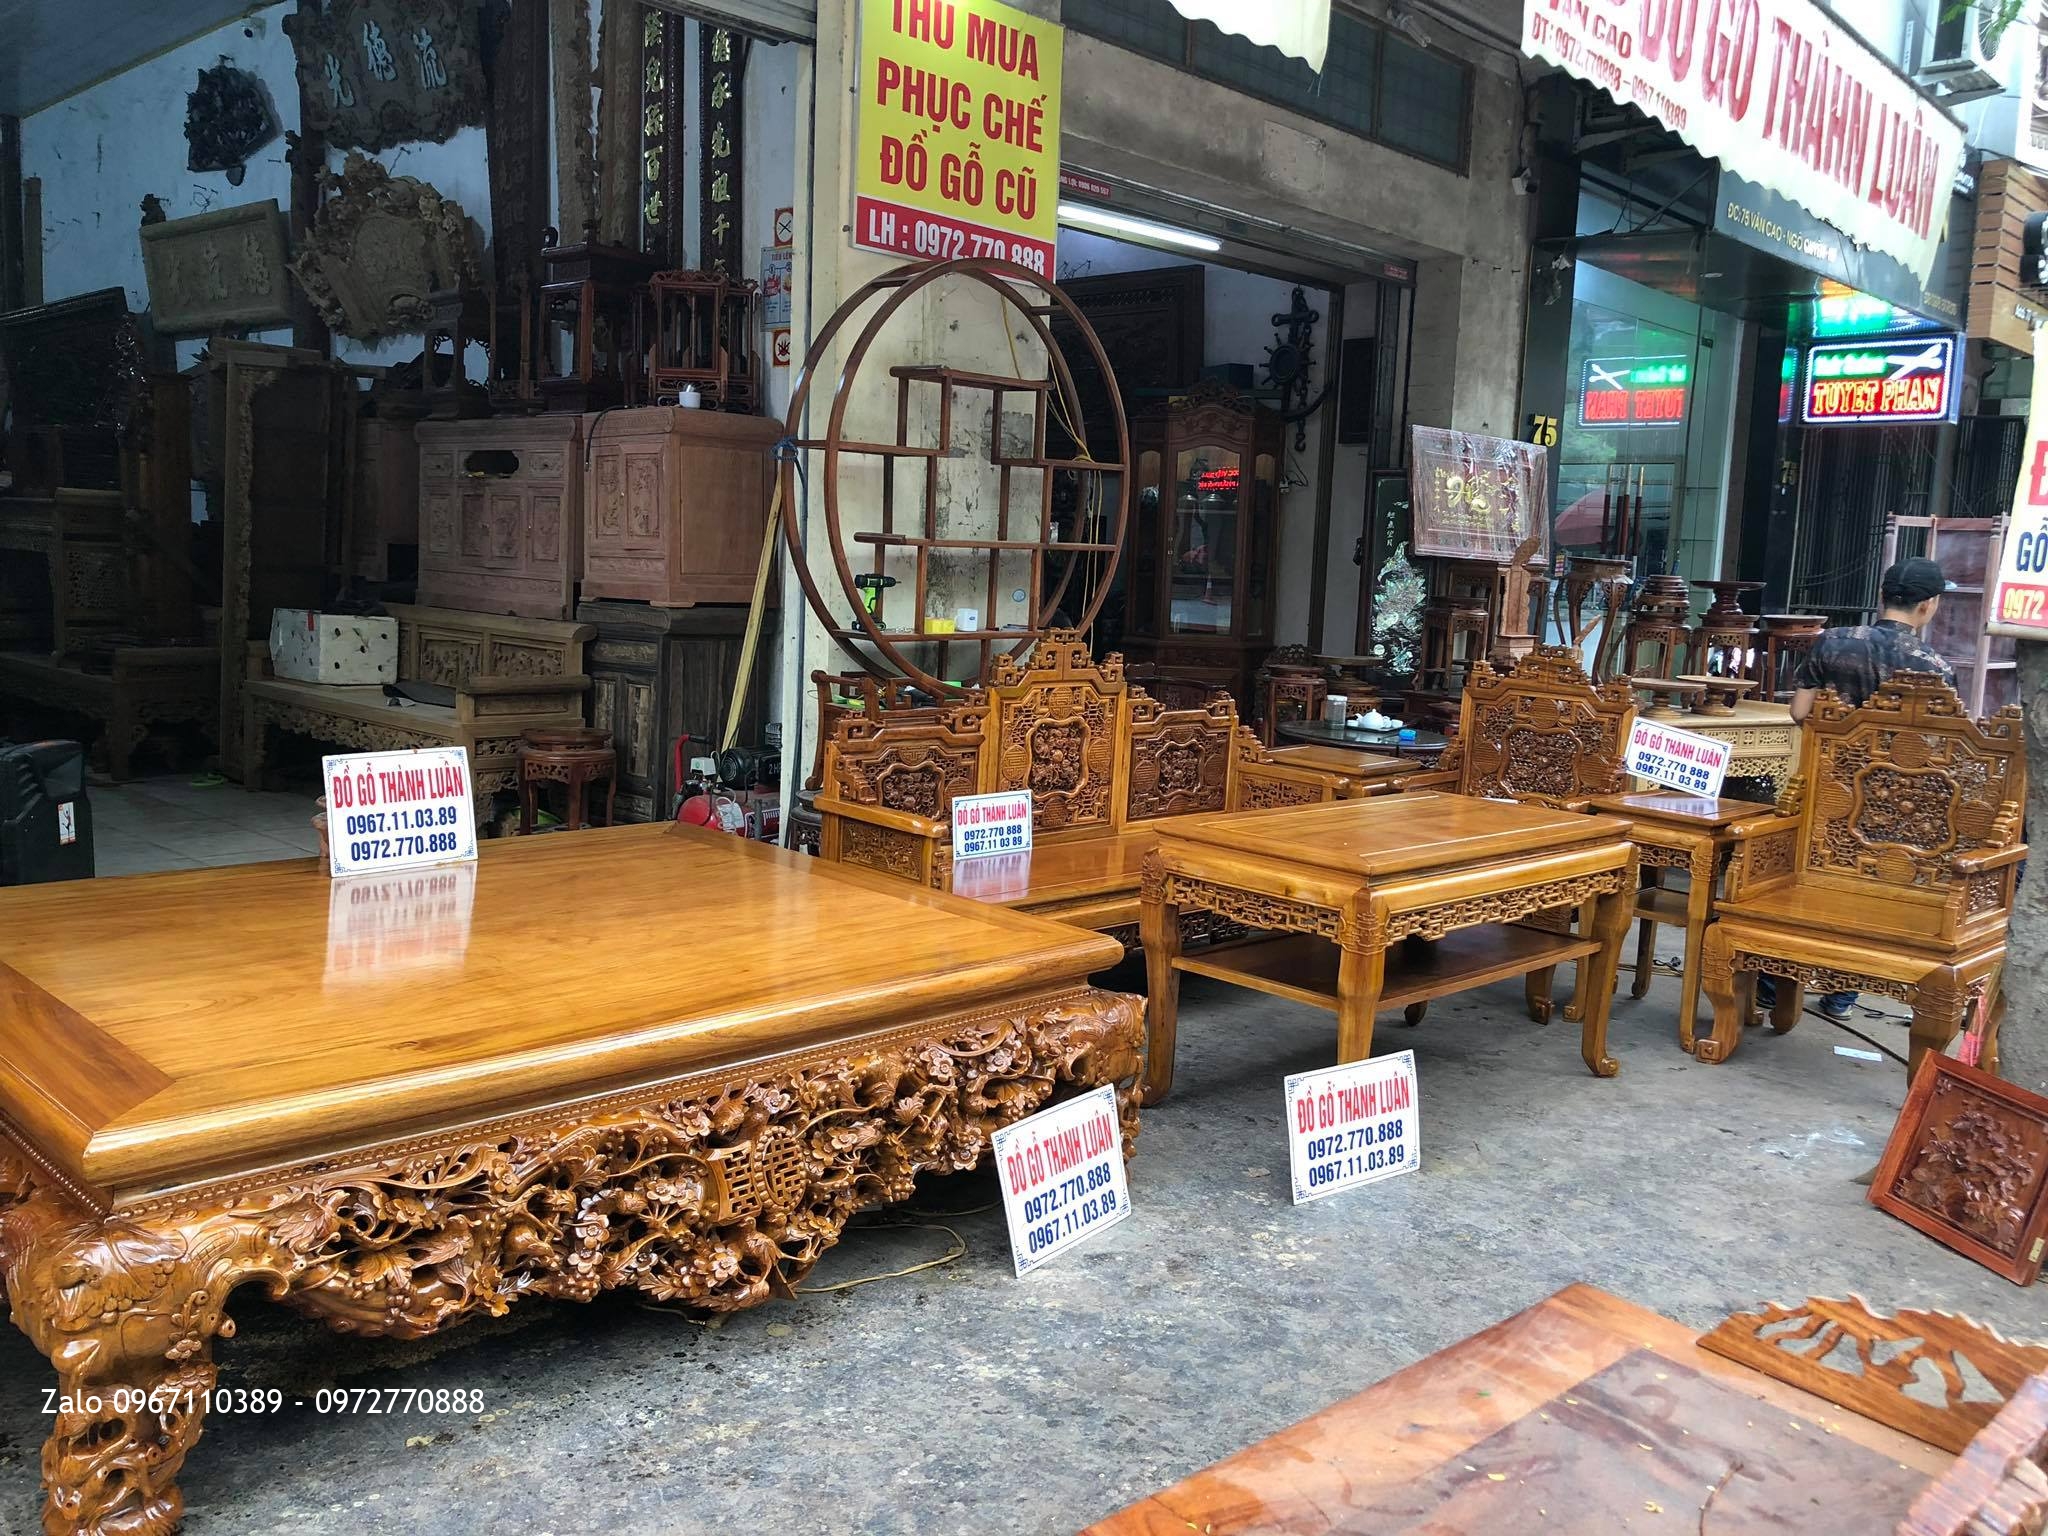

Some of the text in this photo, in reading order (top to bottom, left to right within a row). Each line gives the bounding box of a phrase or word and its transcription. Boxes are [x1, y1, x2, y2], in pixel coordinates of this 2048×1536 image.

[892, 0, 1039, 81] THU MUA
[1592, 14, 1632, 59] CAO
[877, 57, 1048, 153] PHỤC CHẾ
[880, 129, 1037, 220] ĐỒ GỖ CŨ
[869, 209, 895, 246] LH
[1765, 221, 1782, 241] CAO
[1880, 377, 1941, 412] PHAN
[1533, 415, 1557, 447] 75
[2002, 587, 2046, 620] 0972
[333, 760, 464, 808] ĐỒ GỖ THÀNH LUÂN
[346, 806, 457, 835] 0967.11.03.89
[351, 832, 457, 861] 0972.770.888
[1297, 1071, 1410, 1134] ĐỒ GỖ THÀNH LUÂN
[1007, 1109, 1114, 1195] ĐỒ GỖ THÀNH LUÂN
[1308, 1119, 1403, 1161] 0972.770.888
[1308, 1144, 1404, 1187] 0967.11.03.89
[1024, 1162, 1111, 1224] 0972.770.888
[1028, 1189, 1117, 1254] 0967.11.03.89
